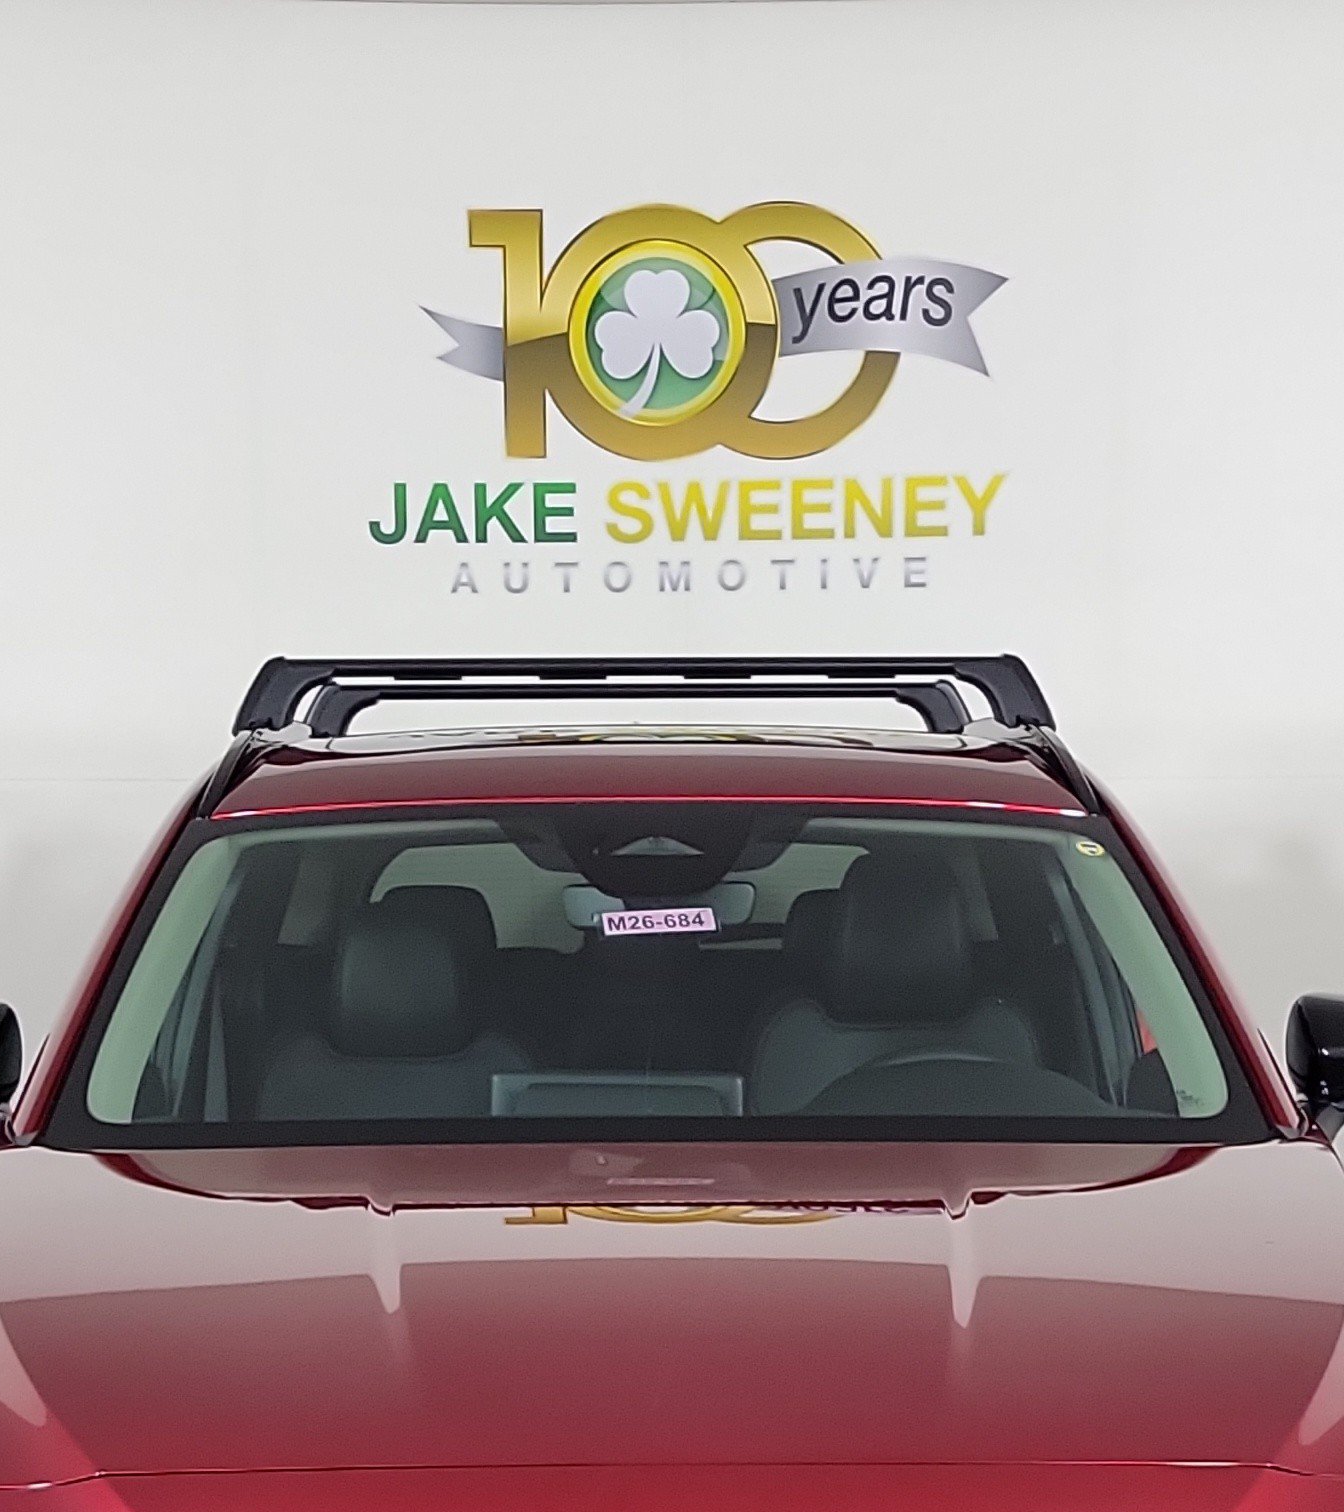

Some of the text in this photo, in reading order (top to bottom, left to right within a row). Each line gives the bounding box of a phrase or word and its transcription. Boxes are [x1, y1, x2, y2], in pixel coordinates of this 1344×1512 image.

[791, 274, 955, 343] years
[368, 473, 1008, 545] JAKE SWEENEY
[450, 556, 929, 595] AUTOMOTIVE
[607, 911, 705, 933] M26-684
